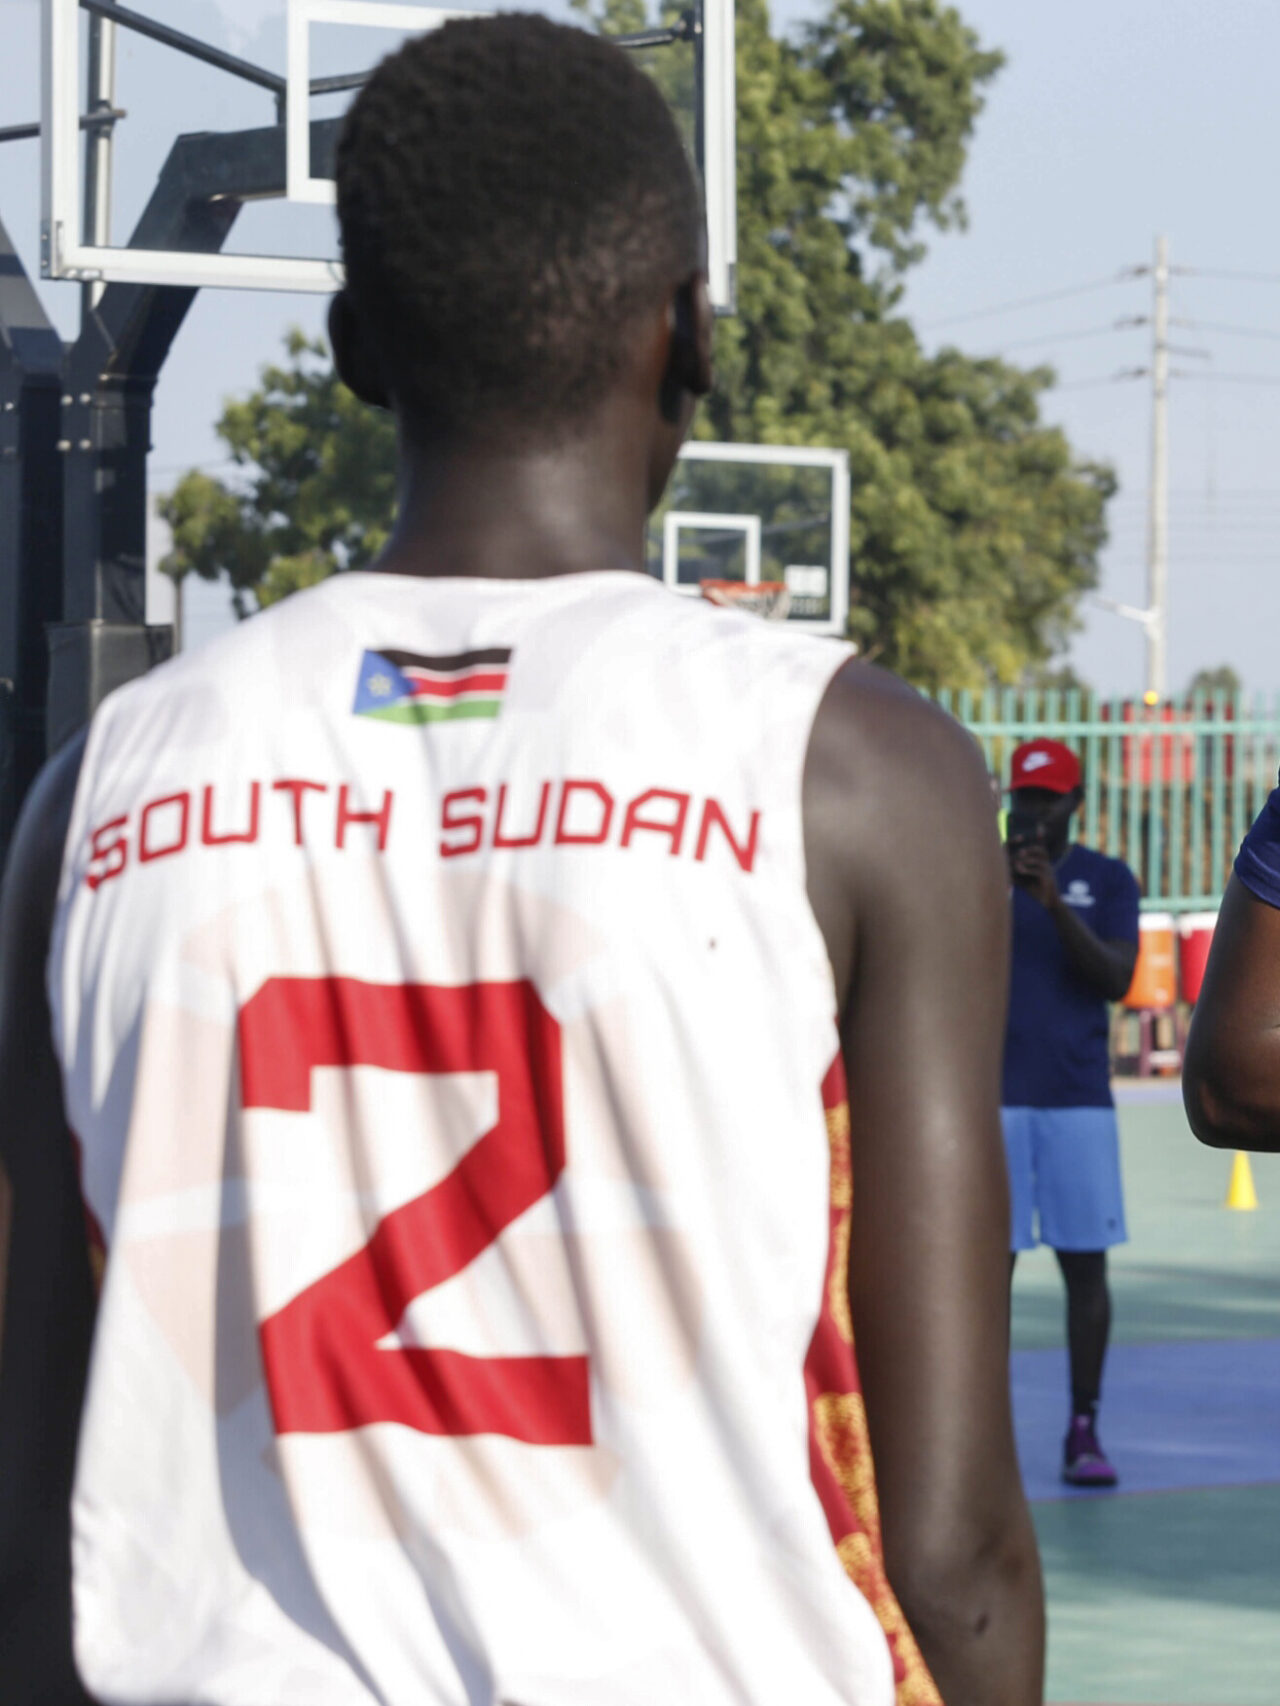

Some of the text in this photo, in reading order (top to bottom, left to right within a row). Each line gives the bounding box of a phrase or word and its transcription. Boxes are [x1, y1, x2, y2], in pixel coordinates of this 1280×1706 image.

[84, 780, 762, 891] SOUTH SUDAN
[239, 975, 594, 1447] 2
